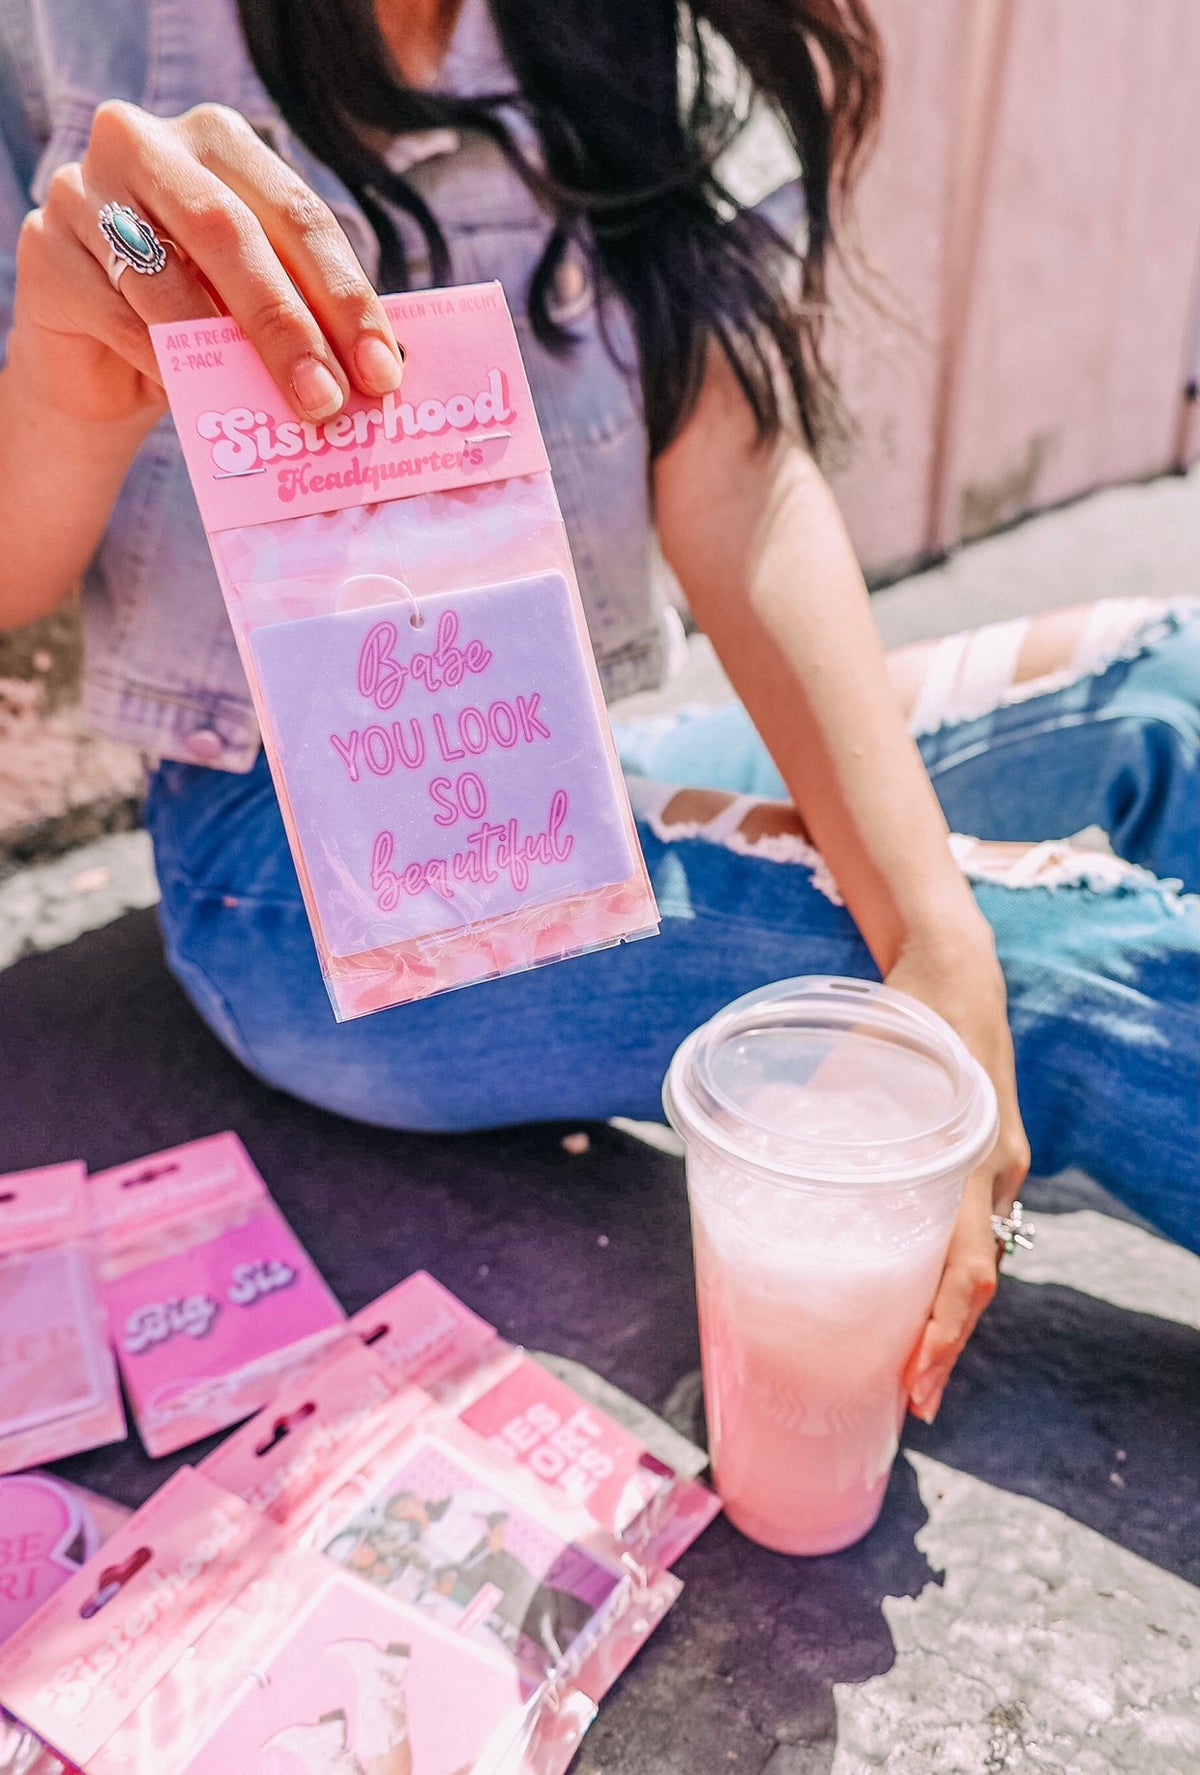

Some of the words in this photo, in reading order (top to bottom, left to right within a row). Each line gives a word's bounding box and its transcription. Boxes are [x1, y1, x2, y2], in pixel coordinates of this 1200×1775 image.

[166, 332, 191, 351] AIR
[429, 299, 455, 316] TEA
[459, 295, 498, 313] SCENT
[171, 351, 224, 372] 2-PACK
[197, 368, 516, 474] Sisterhood
[277, 445, 485, 502] Headquarters
[356, 609, 493, 711] Babe
[330, 717, 425, 782] YOU
[433, 692, 551, 762] LOOK
[428, 771, 487, 827] SO
[371, 790, 574, 912] beautiful
[124, 1296, 221, 1355] Big
[227, 1259, 298, 1308] Sis
